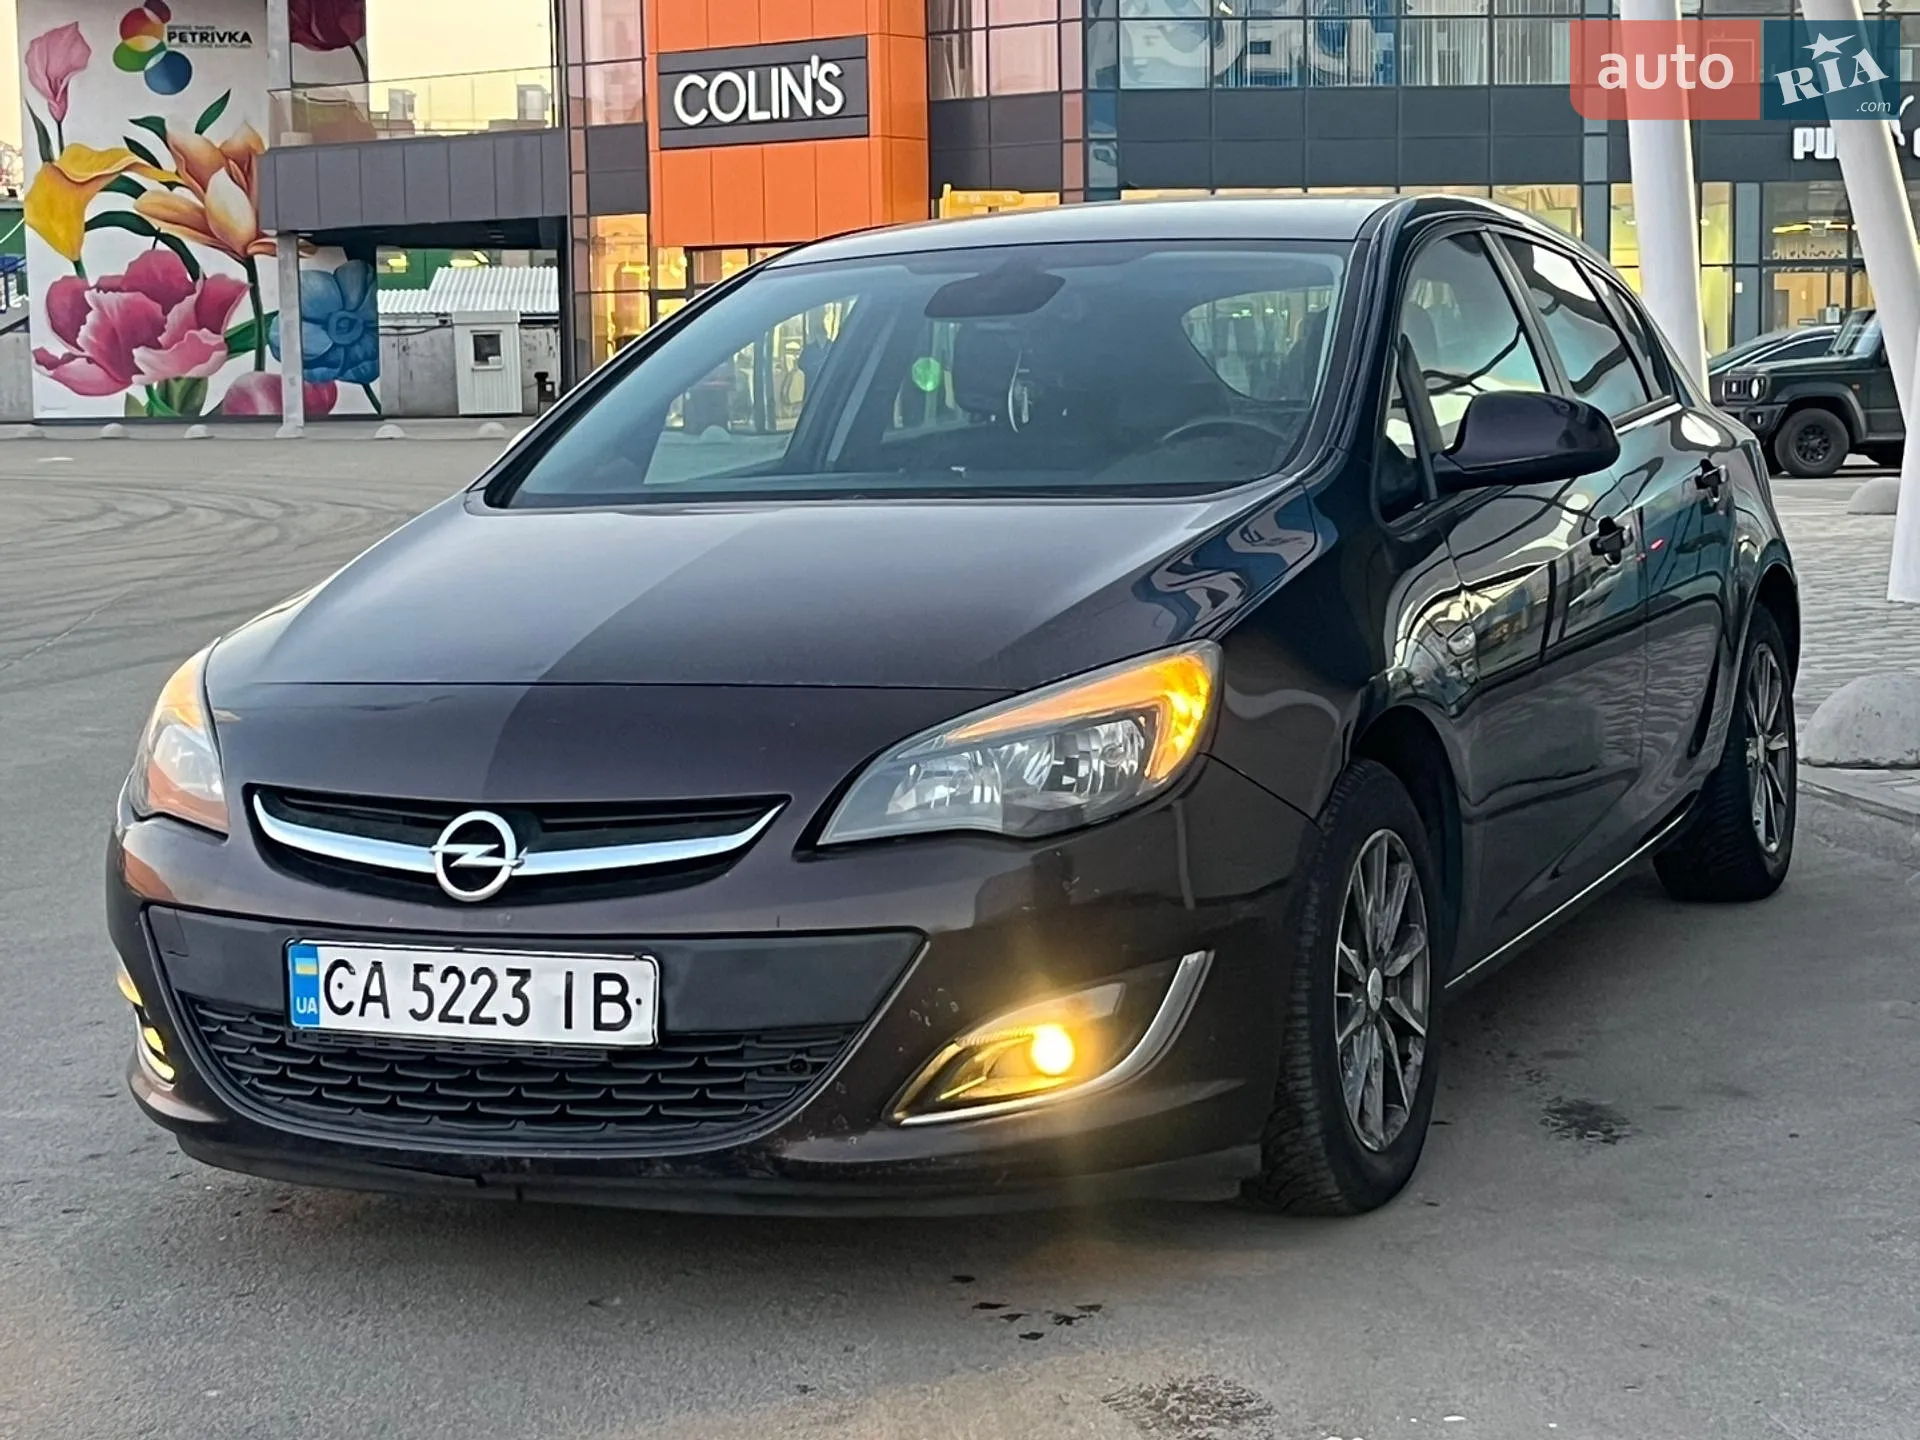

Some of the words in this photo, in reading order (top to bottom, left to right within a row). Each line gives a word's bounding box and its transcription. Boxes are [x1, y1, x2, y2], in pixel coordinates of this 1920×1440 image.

[167, 31, 253, 43] PETRIVKA
[673, 54, 845, 126] COLIN'S
[1793, 127, 1839, 160] PU
[295, 996, 319, 1015] UA
[323, 958, 391, 1019] CA
[408, 962, 533, 1027] 5223
[563, 969, 633, 1032] IB
